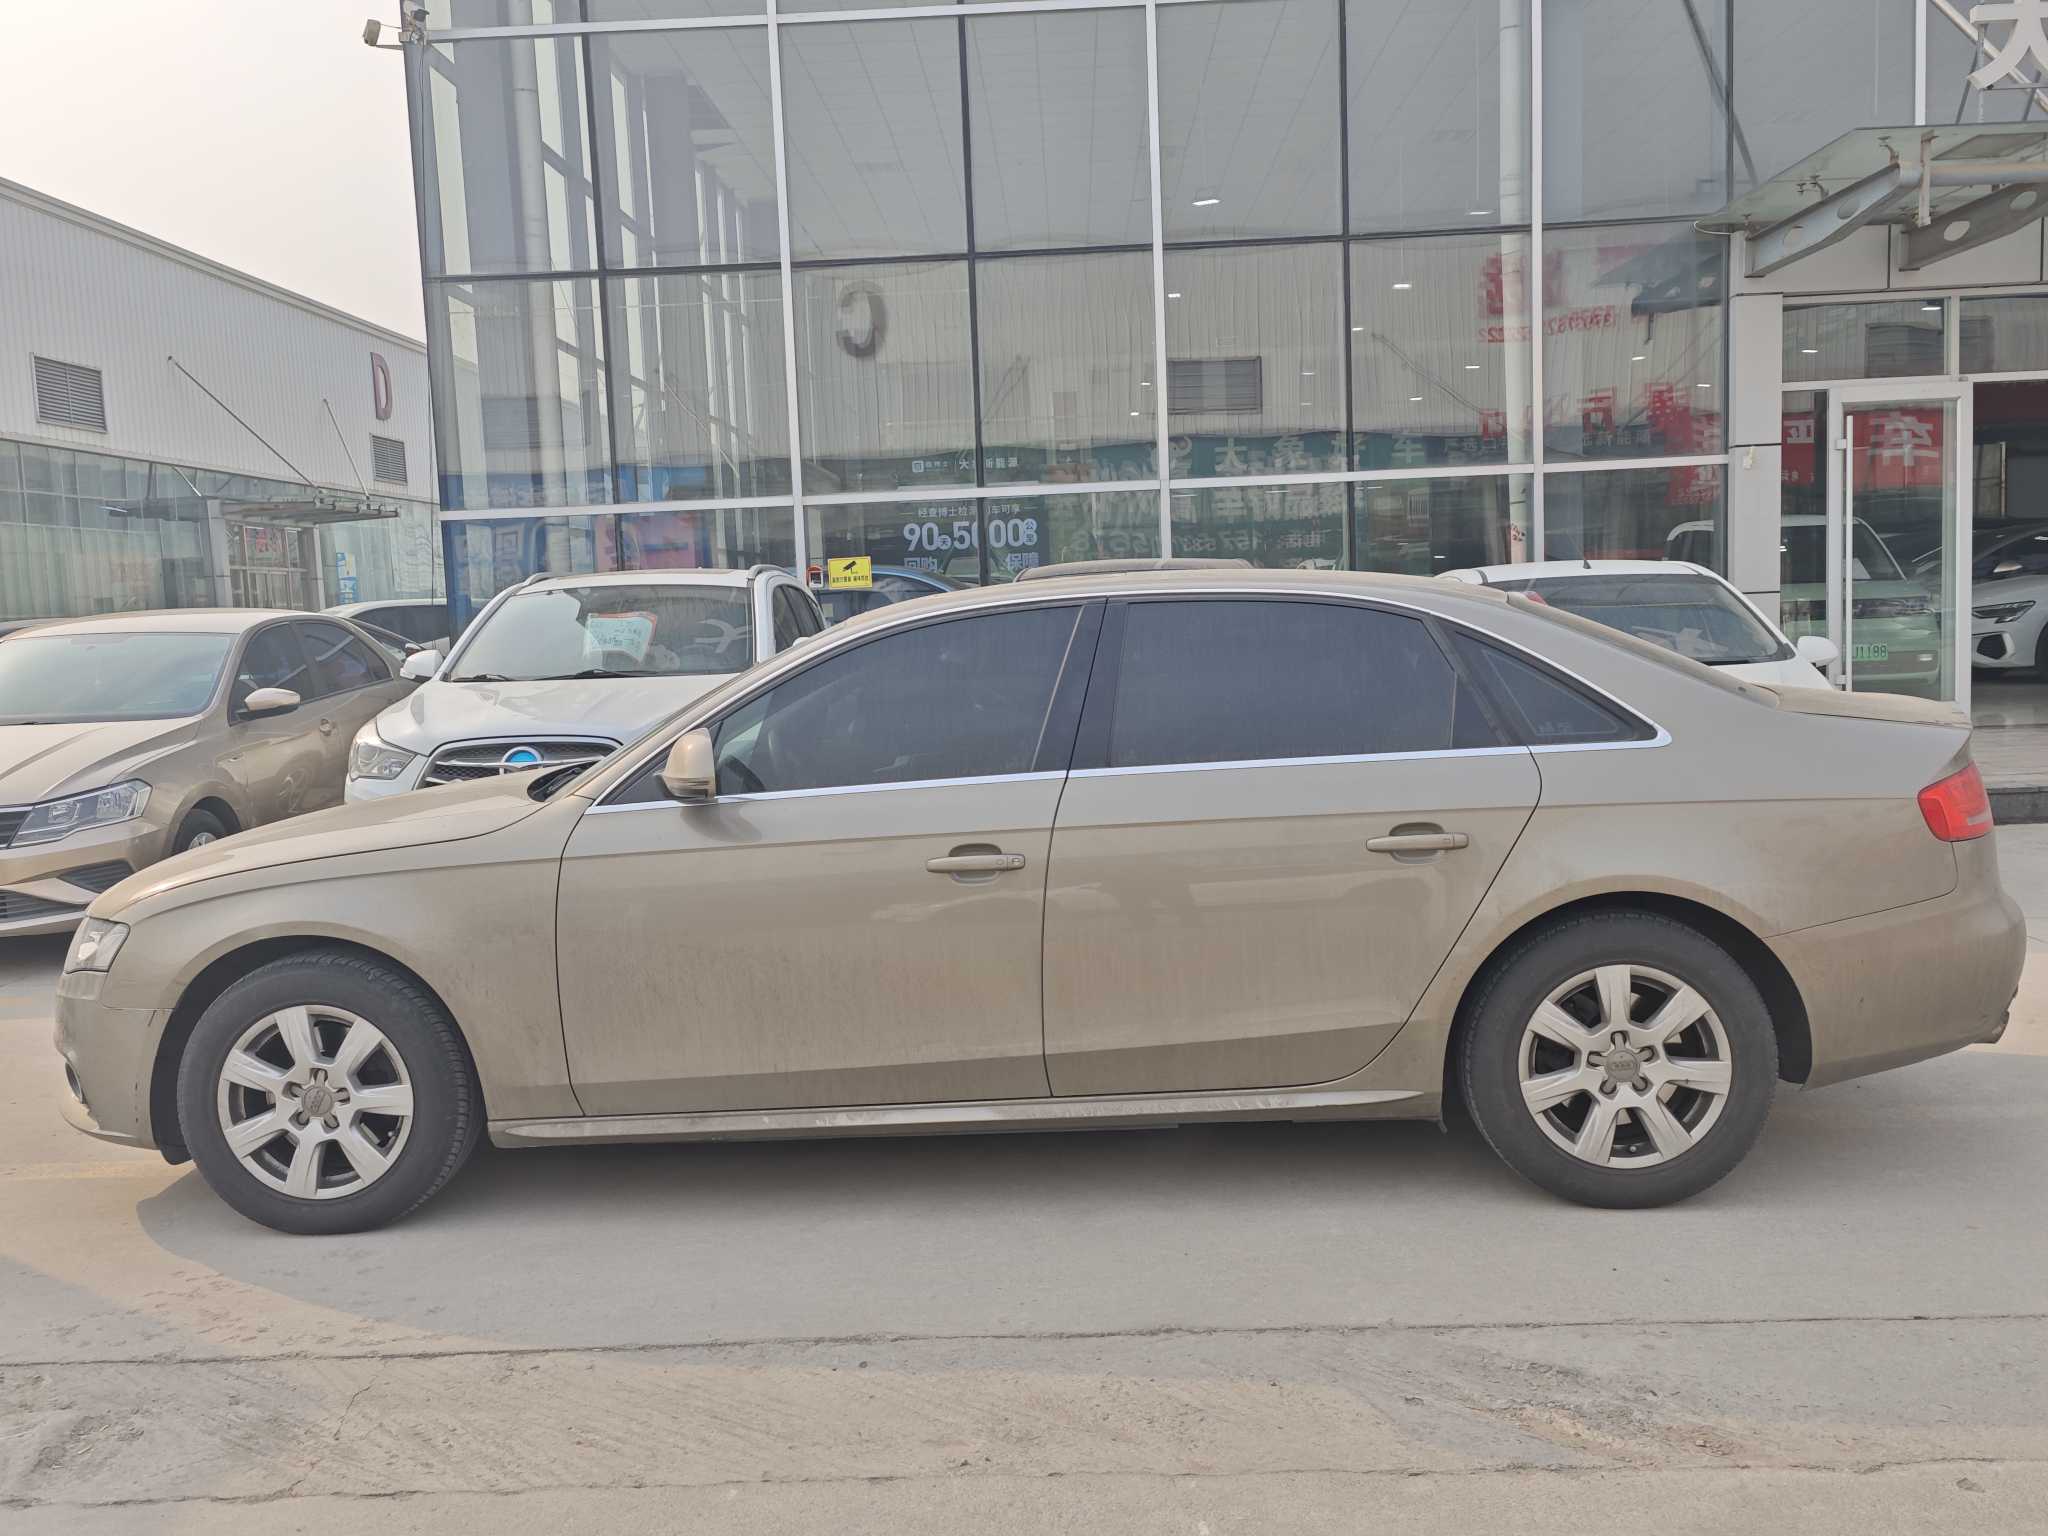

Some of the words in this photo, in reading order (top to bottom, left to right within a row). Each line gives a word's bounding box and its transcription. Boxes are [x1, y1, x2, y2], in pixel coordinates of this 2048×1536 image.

[370, 351, 392, 420] D
[959, 457, 1018, 470] 大新能源
